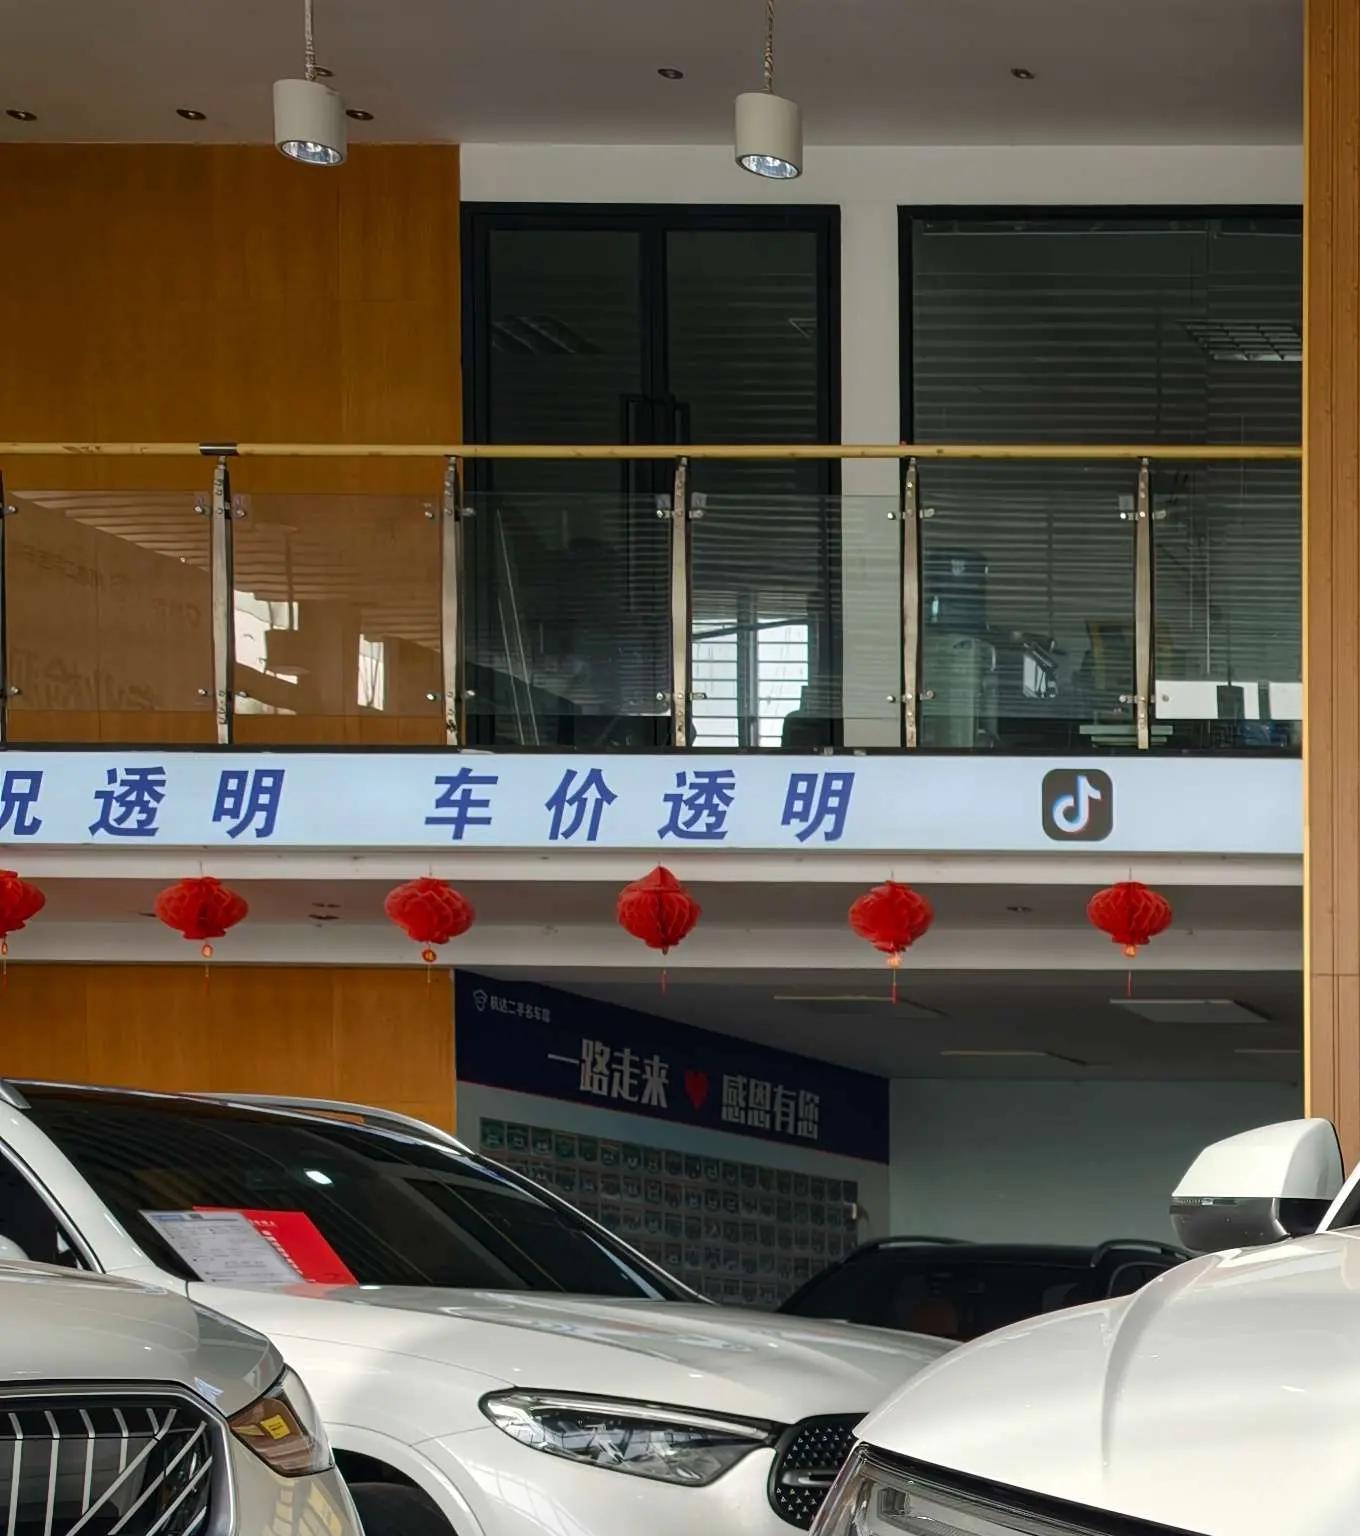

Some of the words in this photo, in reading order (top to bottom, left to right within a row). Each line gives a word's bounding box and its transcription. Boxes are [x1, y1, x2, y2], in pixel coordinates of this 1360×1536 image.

[425, 767, 856, 842] 车价透明
[547, 1037, 669, 1109] 一路走来
[720, 1073, 821, 1141] 感恩有您
